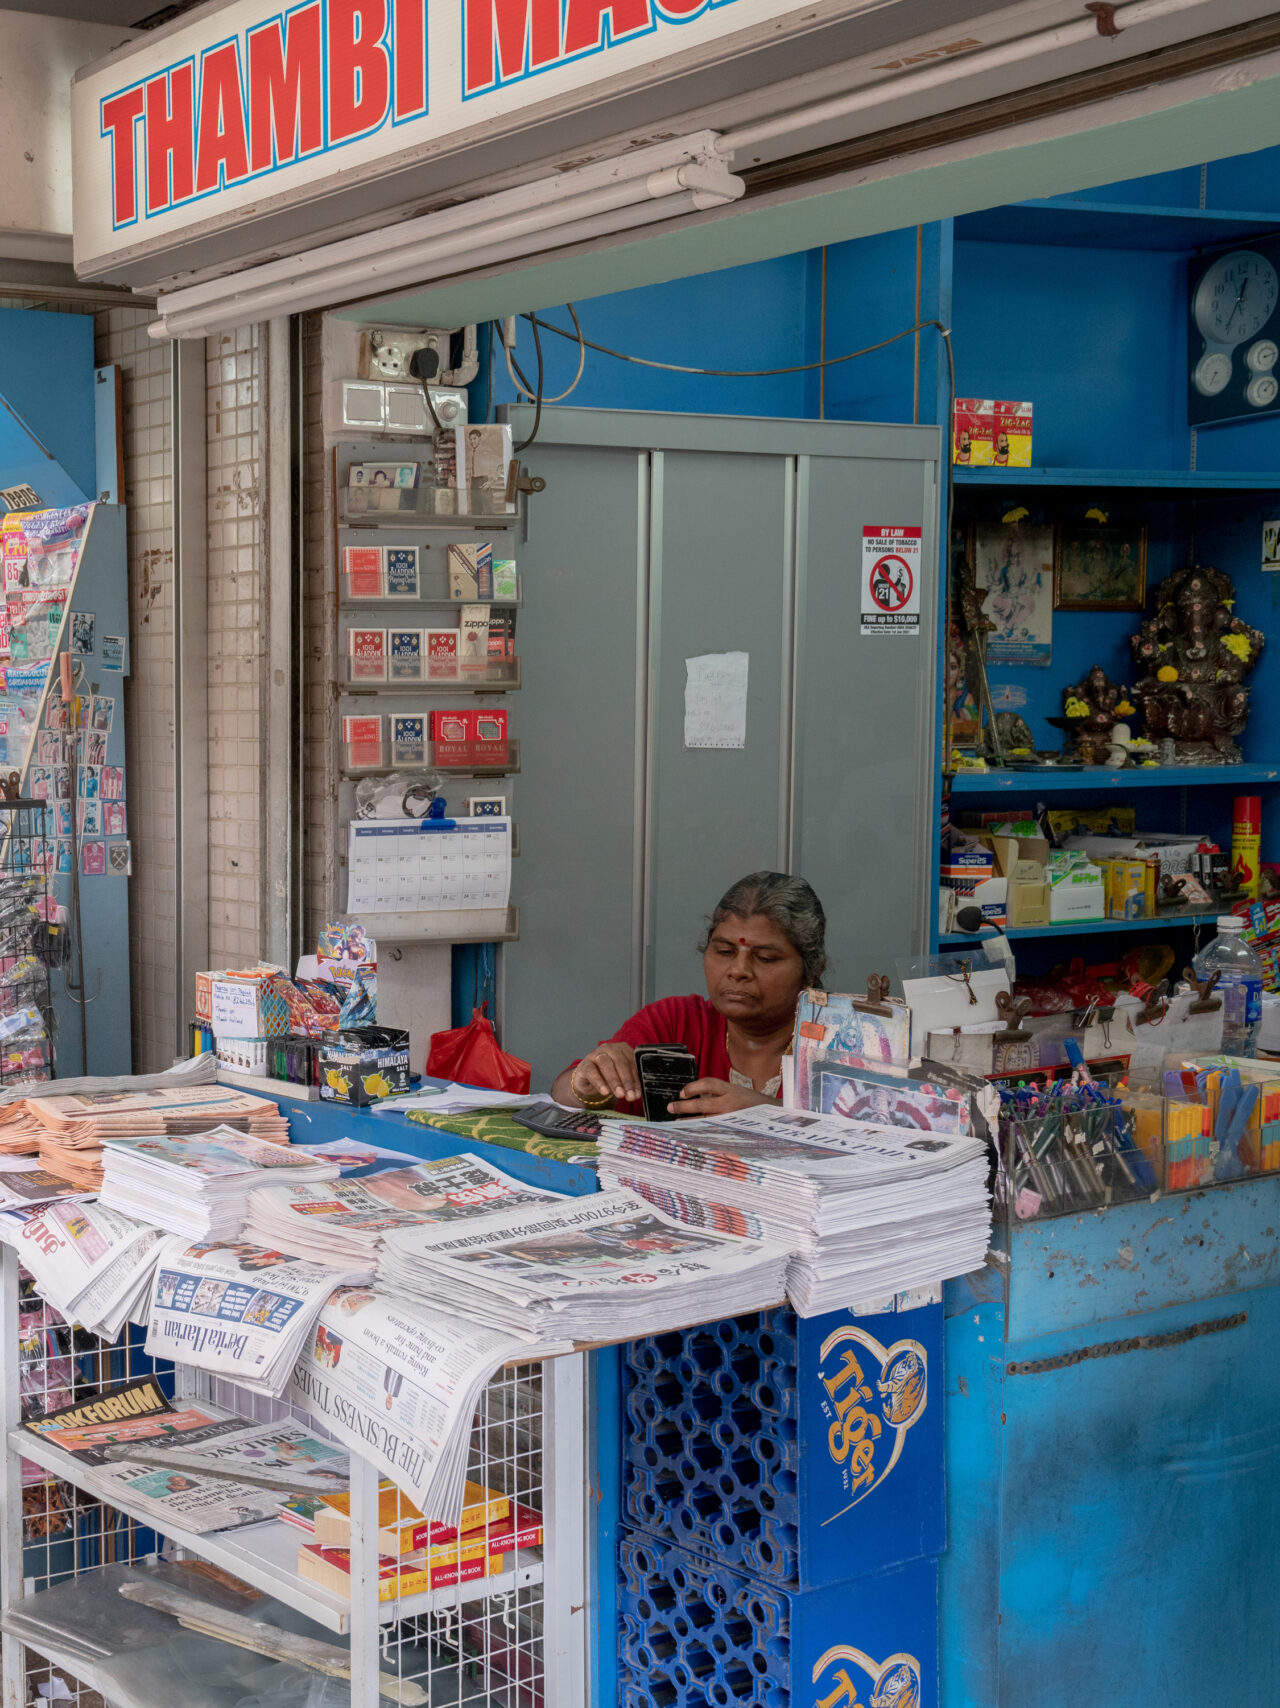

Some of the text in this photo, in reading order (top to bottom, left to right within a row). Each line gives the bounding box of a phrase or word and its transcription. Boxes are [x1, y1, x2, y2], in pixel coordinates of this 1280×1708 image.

[100, 0, 429, 231] THAMBI
[1000, 416, 1031, 428] ZIG-ZAG
[1, 485, 40, 505] Teens
[6, 562, 19, 580] 85
[390, 567, 415, 577] ALADDIN
[389, 576, 405, 586] Playing
[879, 589, 889, 599] 21
[464, 619, 488, 629] zippo
[894, 616, 917, 624] $10,000
[440, 745, 468, 753] ROYAL
[475, 744, 504, 752] ROYAL
[958, 857, 987, 865] Super25
[377, 1054, 408, 1069] HIMALAYA
[851, 1137, 917, 1162] TIMES
[164, 1319, 249, 1360] Berita Harian
[363, 1328, 381, 1345] boon
[385, 1315, 445, 1355] co-living operators
[385, 1341, 408, 1363] rentals
[394, 1334, 437, 1364] and bane for
[408, 1355, 429, 1378] Rising
[820, 1400, 832, 1419] EST
[293, 1362, 426, 1489] THE BUSINESS TIMES
[823, 1348, 882, 1497] Tiger
[198, 1430, 308, 1459] DAY TIMES
[841, 1469, 849, 1492] 1932
[189, 1492, 227, 1505] blame
[227, 1487, 242, 1496] for
[223, 1488, 264, 1502] deaths
[491, 1533, 536, 1548] ALL-KNOWING BOOK
[434, 1566, 482, 1582] ALL-KNOWING BOOK
